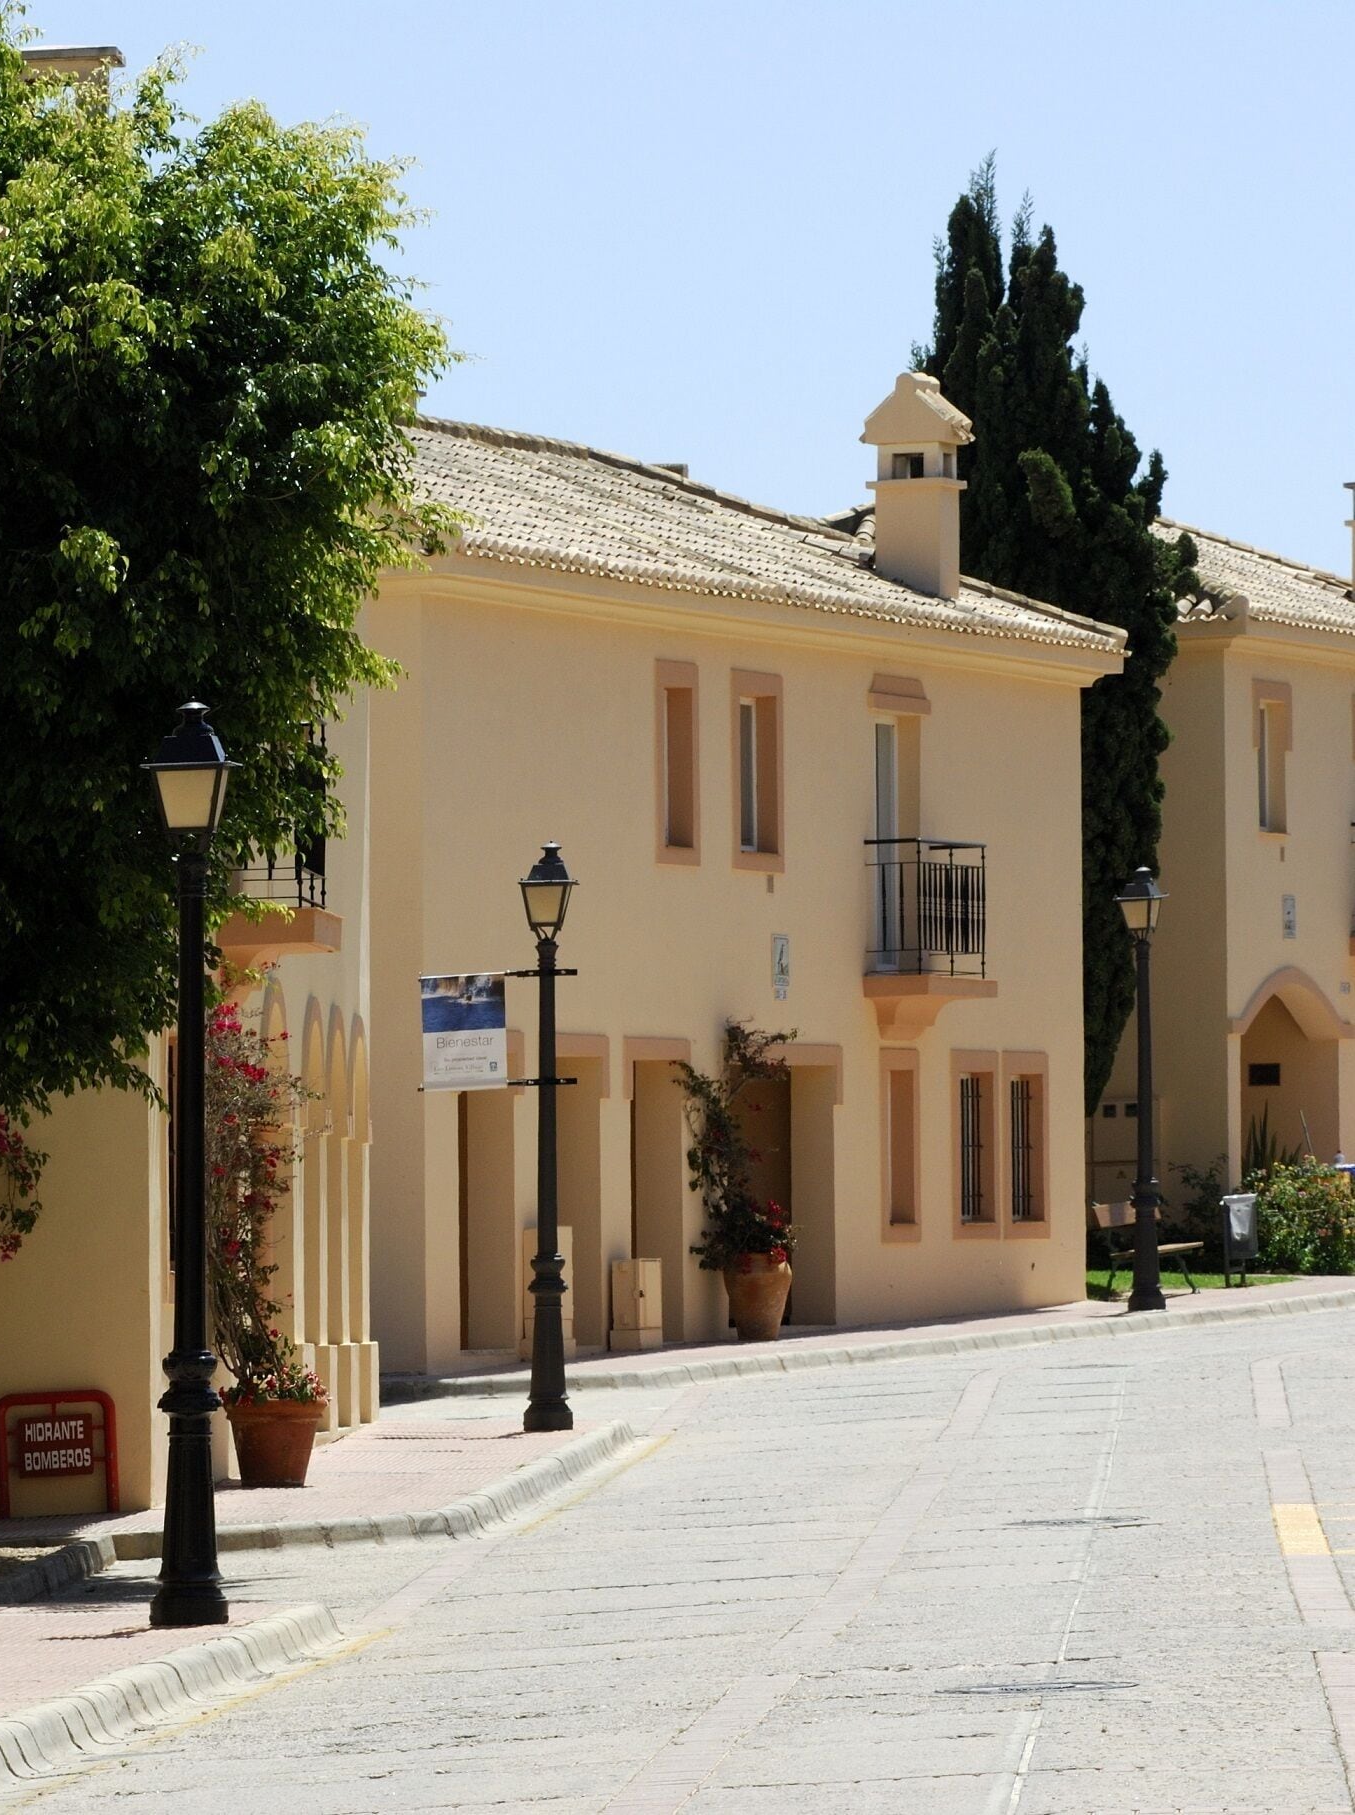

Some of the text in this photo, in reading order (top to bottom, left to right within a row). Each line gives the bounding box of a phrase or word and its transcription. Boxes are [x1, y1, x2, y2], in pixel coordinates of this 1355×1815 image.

[436, 1036, 494, 1049] Bienestar
[25, 1420, 84, 1442] HIDRANTE
[24, 1448, 92, 1471] BOMBEROS
